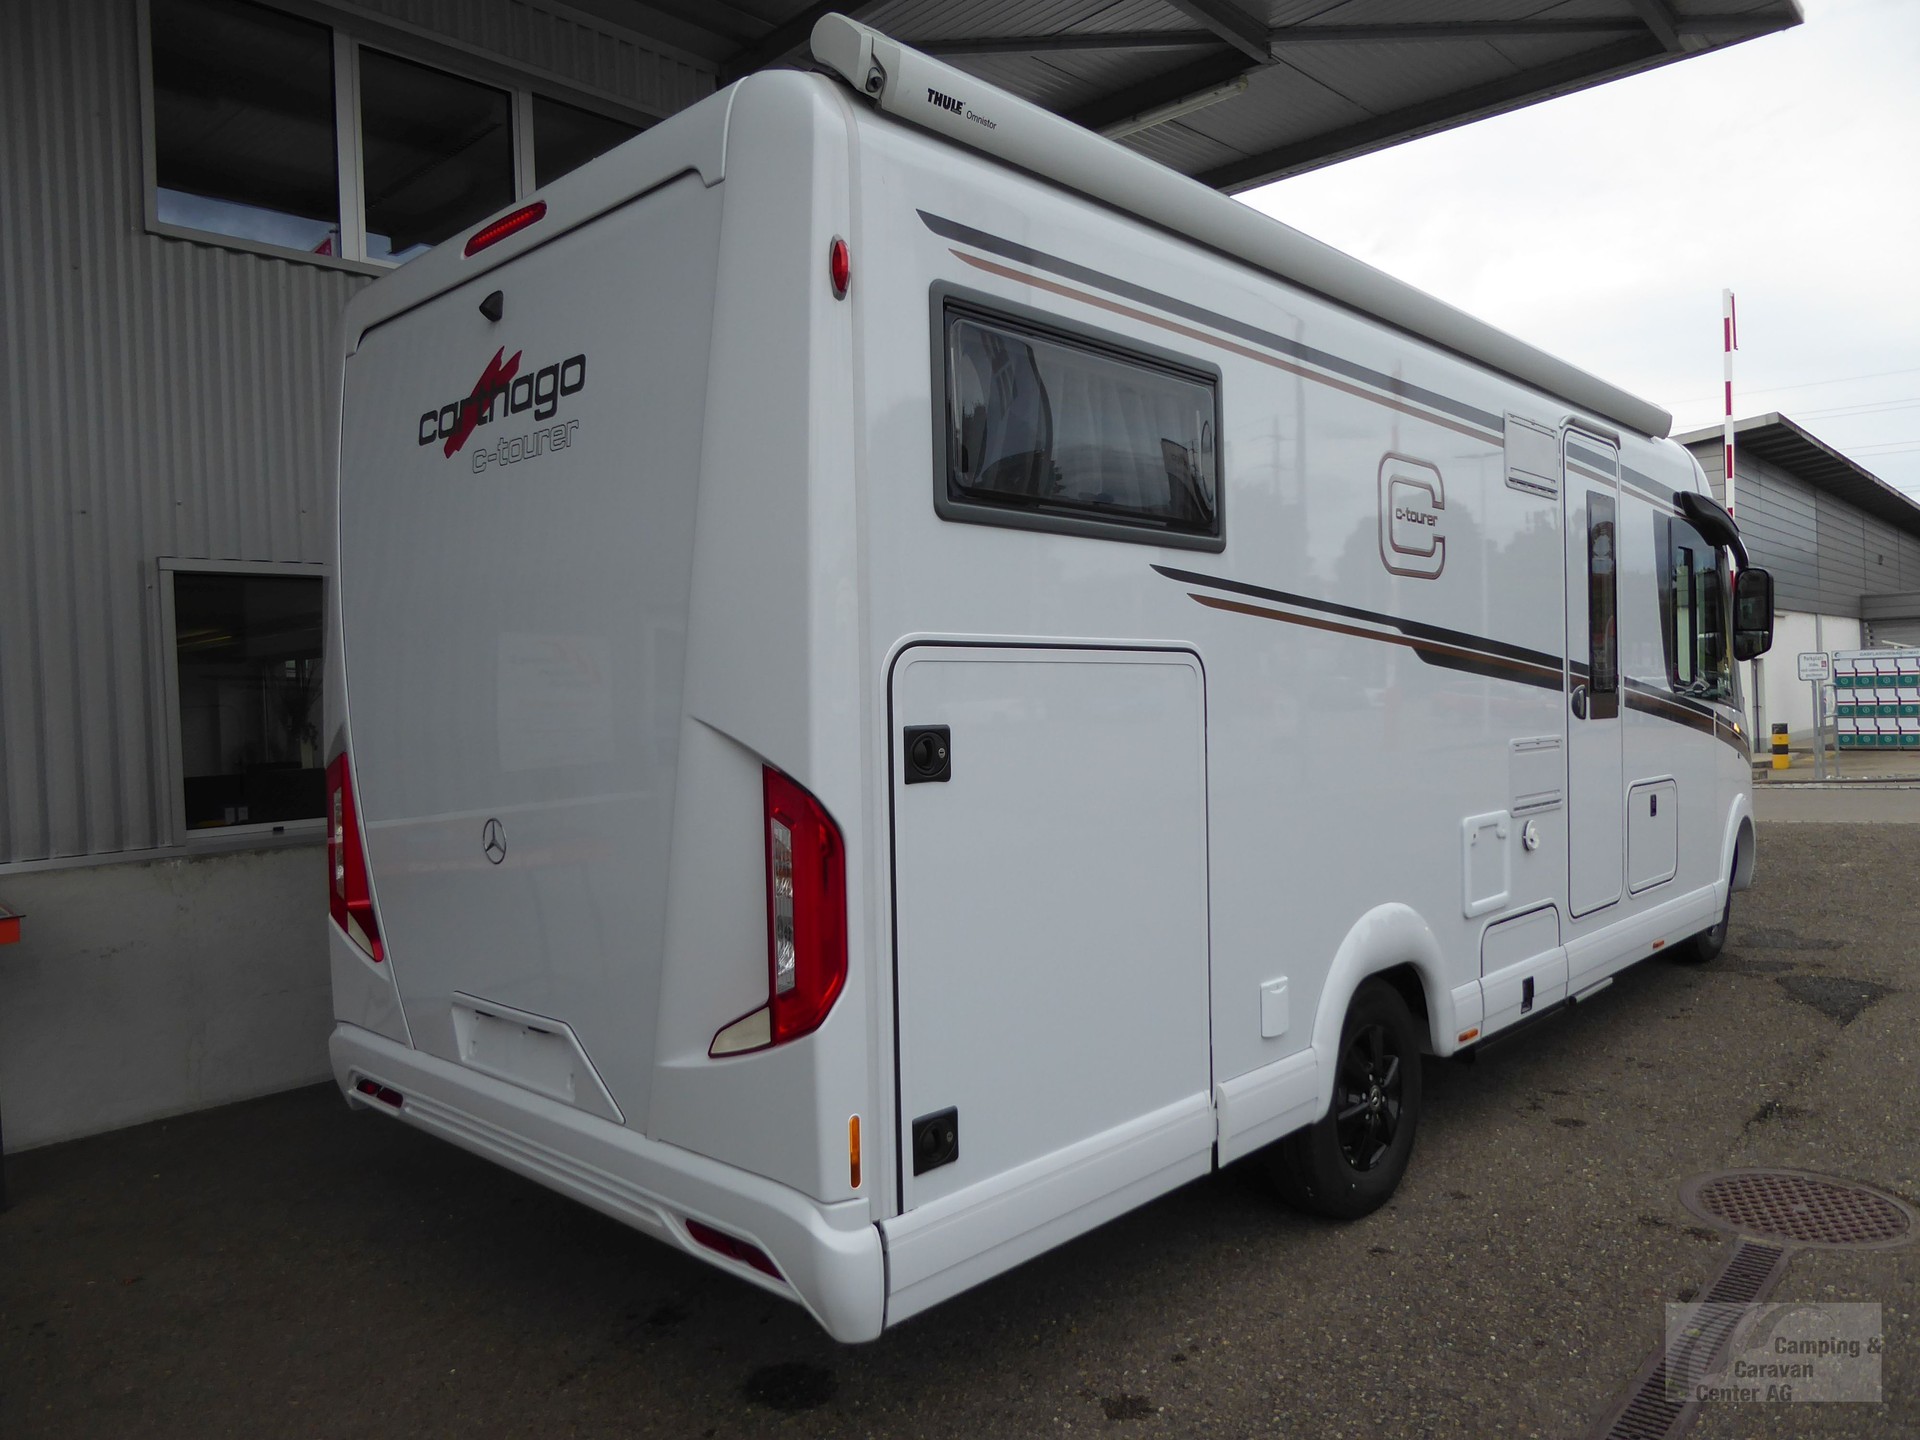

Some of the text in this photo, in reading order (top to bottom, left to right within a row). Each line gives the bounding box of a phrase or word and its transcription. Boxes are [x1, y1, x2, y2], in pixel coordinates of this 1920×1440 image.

[927, 87, 997, 130] THULE Omnistor
[418, 353, 587, 447] carthago
[471, 418, 580, 475] c-tourer
[1395, 507, 1438, 527] c-tourer
